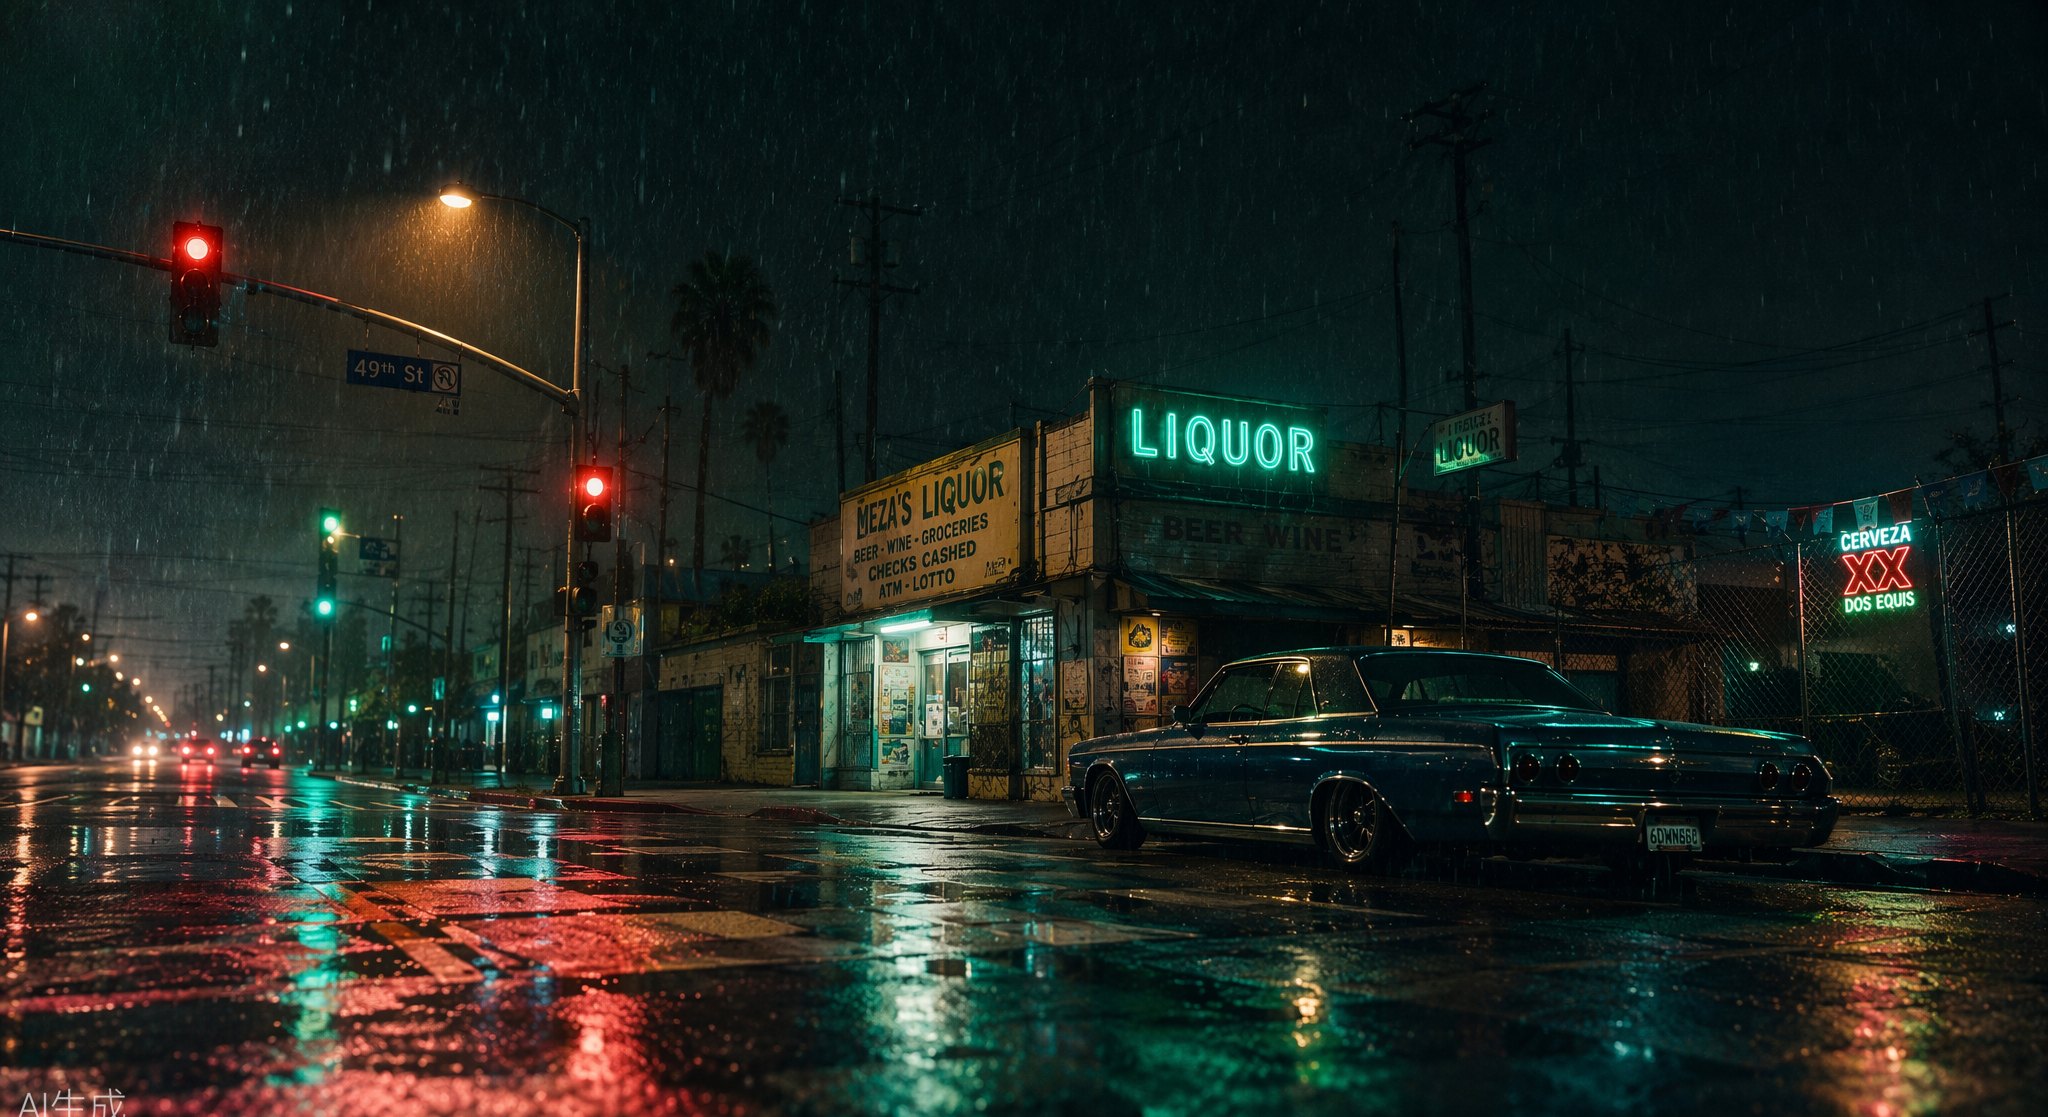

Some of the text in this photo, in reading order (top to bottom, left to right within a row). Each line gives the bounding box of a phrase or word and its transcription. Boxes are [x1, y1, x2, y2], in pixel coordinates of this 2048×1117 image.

[354, 358, 424, 384] 49th St
[1131, 408, 1315, 473] LIQUOR
[856, 460, 1005, 540] MEZA'S LIQUOR
[854, 543, 879, 564] BEER
[887, 535, 912, 555] WINE
[922, 512, 989, 545] GROCERIES
[1163, 515, 1343, 552] BEER WINE
[1841, 524, 1912, 551] CERVEZA
[868, 555, 917, 582] CHECKS
[921, 540, 977, 568] CASHED
[1842, 545, 1913, 596] XX
[879, 579, 902, 599] ATM
[913, 567, 955, 592] LOTTO
[1844, 590, 1915, 614] DOS EQUIS
